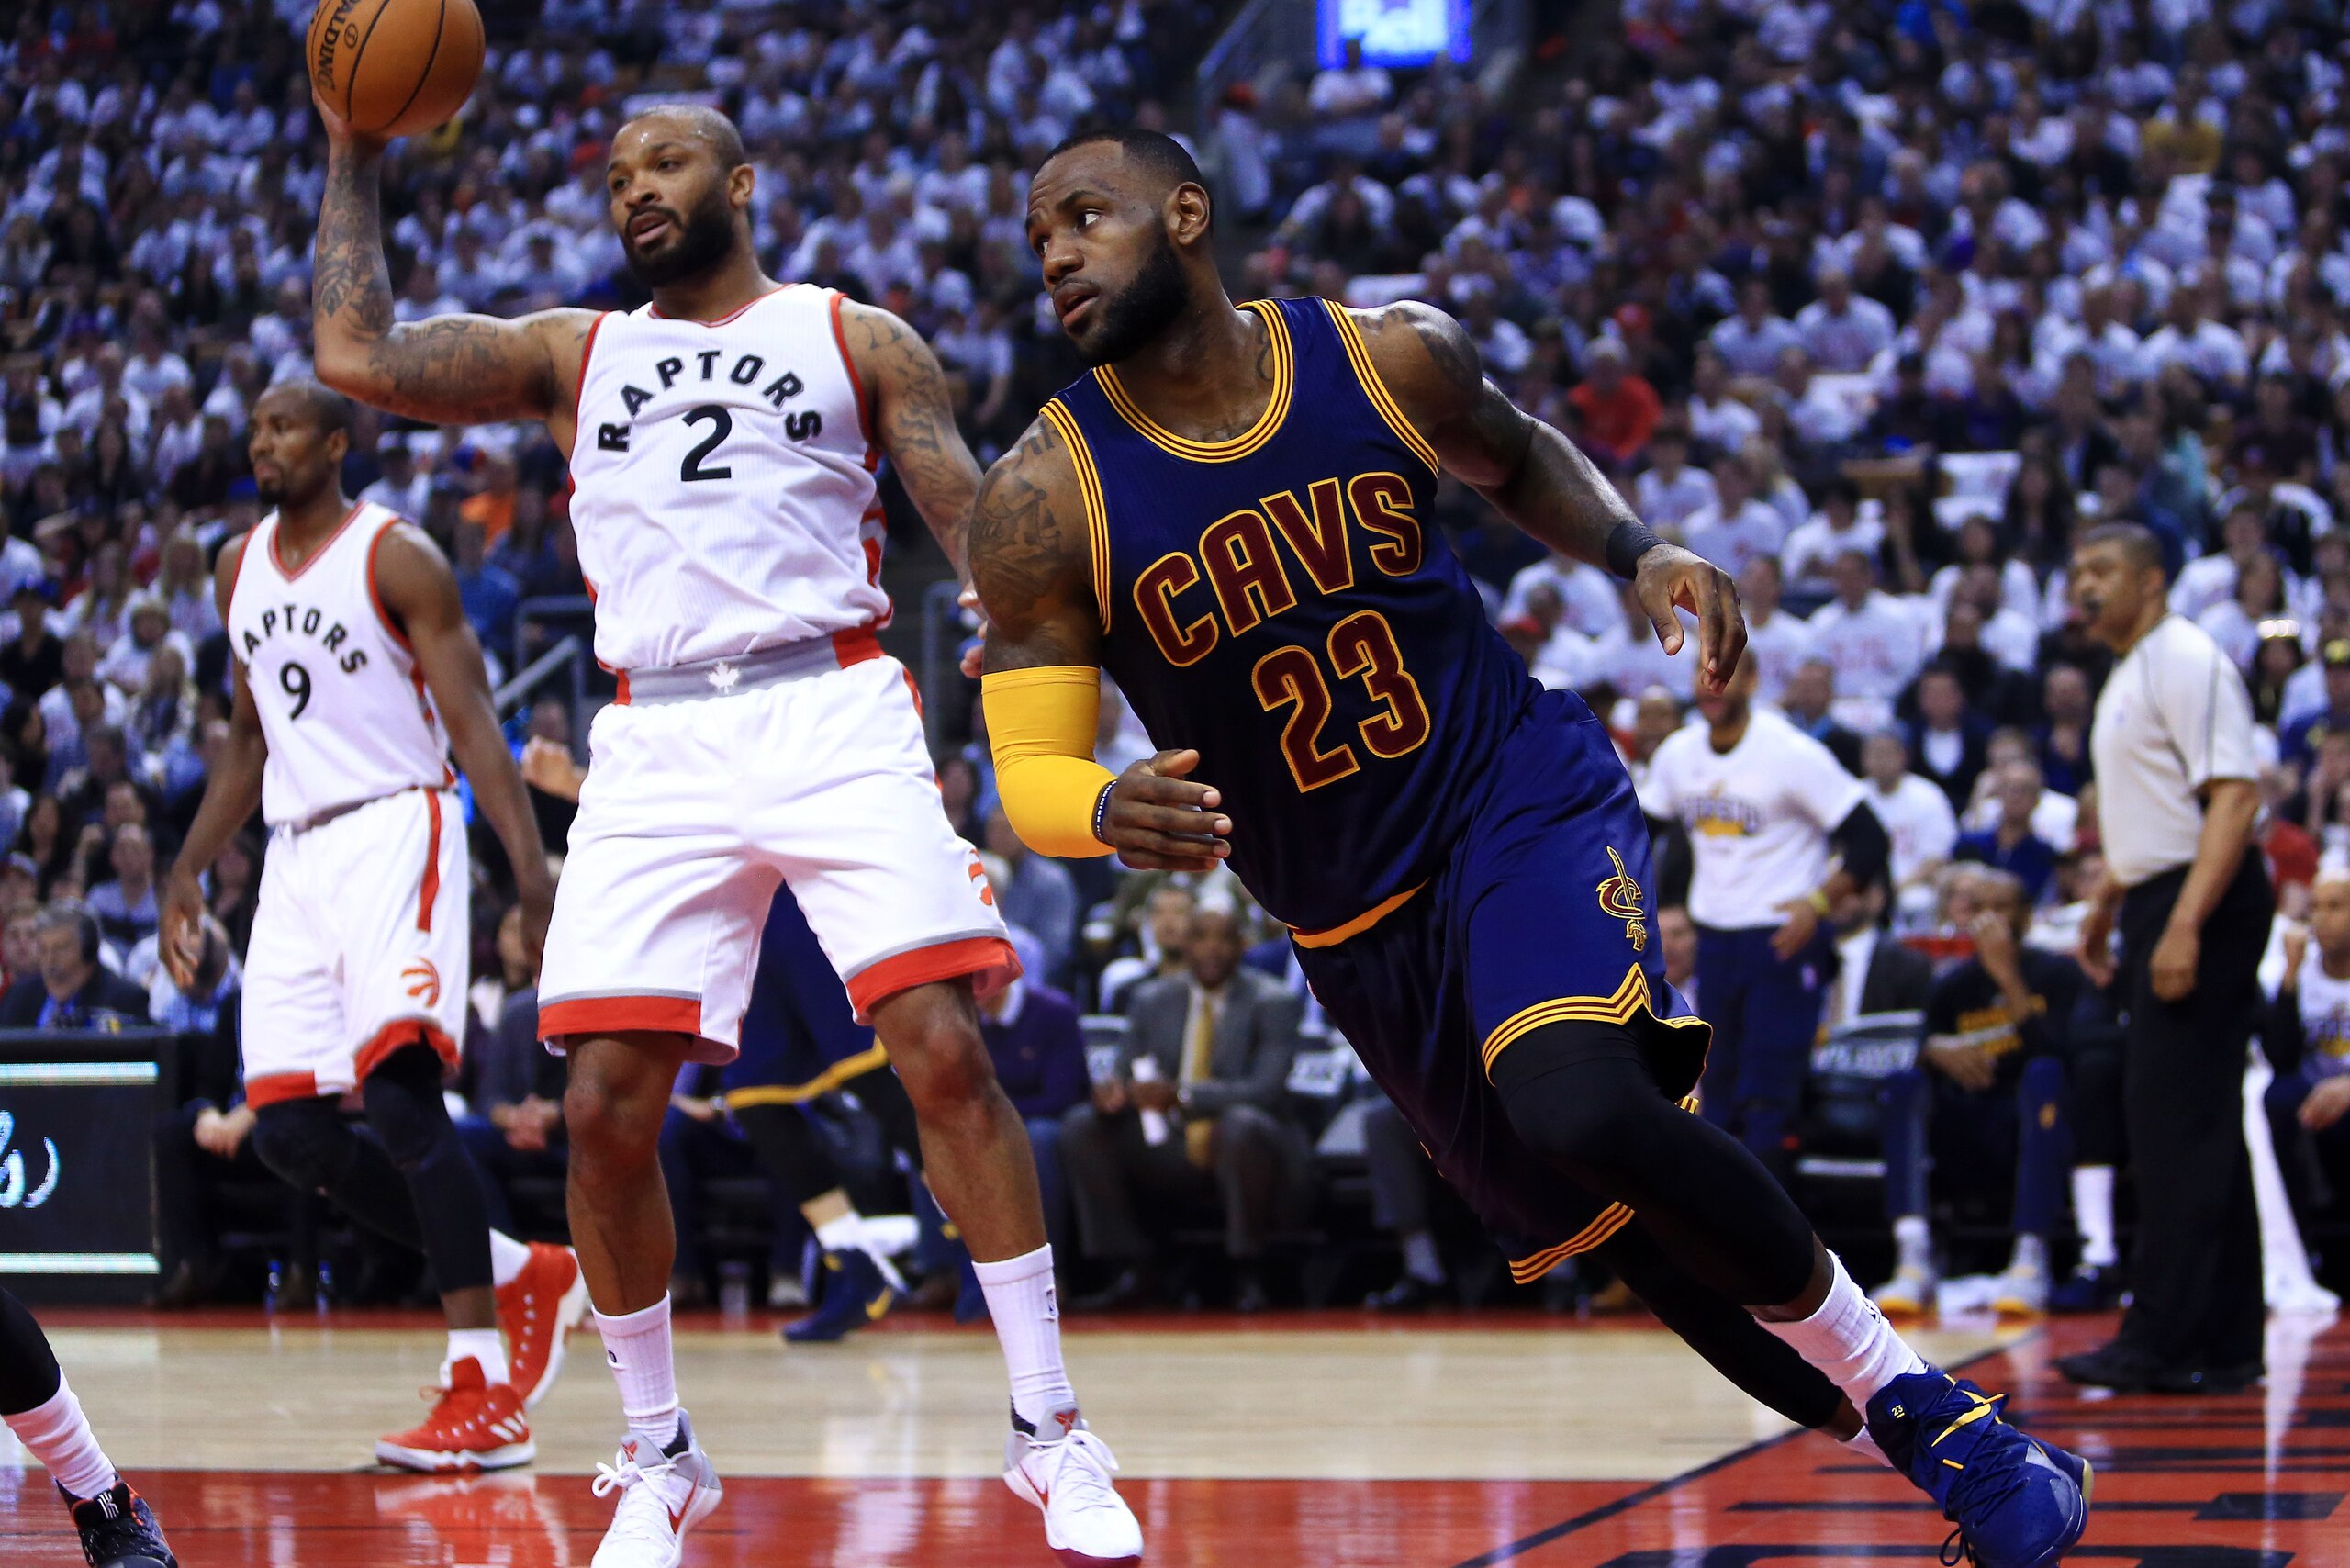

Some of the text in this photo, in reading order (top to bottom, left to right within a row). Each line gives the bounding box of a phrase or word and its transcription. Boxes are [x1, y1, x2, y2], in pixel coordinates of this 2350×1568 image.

[598, 349, 822, 452] RAPTORS
[680, 404, 733, 482] 2
[1133, 471, 1422, 667] CAVS
[280, 661, 311, 721] 9
[1251, 609, 1430, 793] 23
[1891, 1404, 1905, 1416] 23
